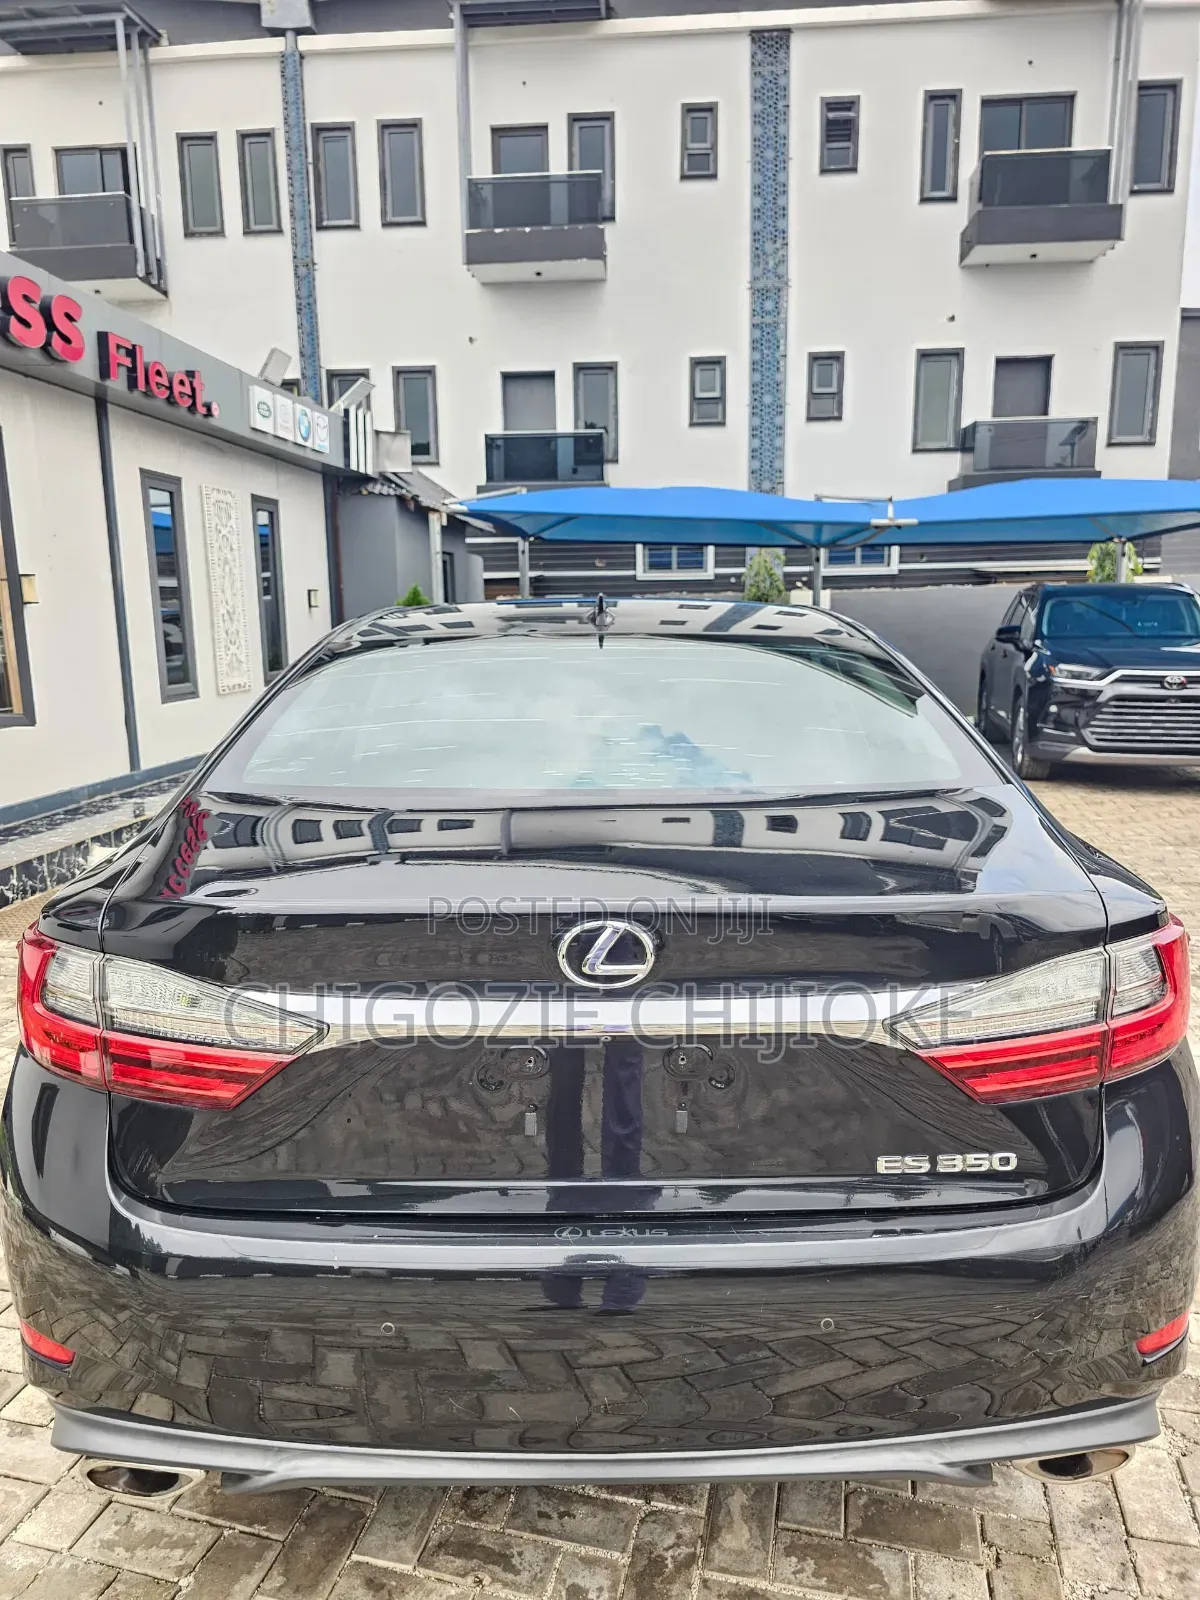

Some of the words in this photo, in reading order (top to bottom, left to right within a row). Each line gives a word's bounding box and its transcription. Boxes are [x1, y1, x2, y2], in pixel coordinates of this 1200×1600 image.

[876, 1154, 931, 1174] ES
[936, 1152, 1018, 1173] 350
[586, 1228, 669, 1238] LEXUS
